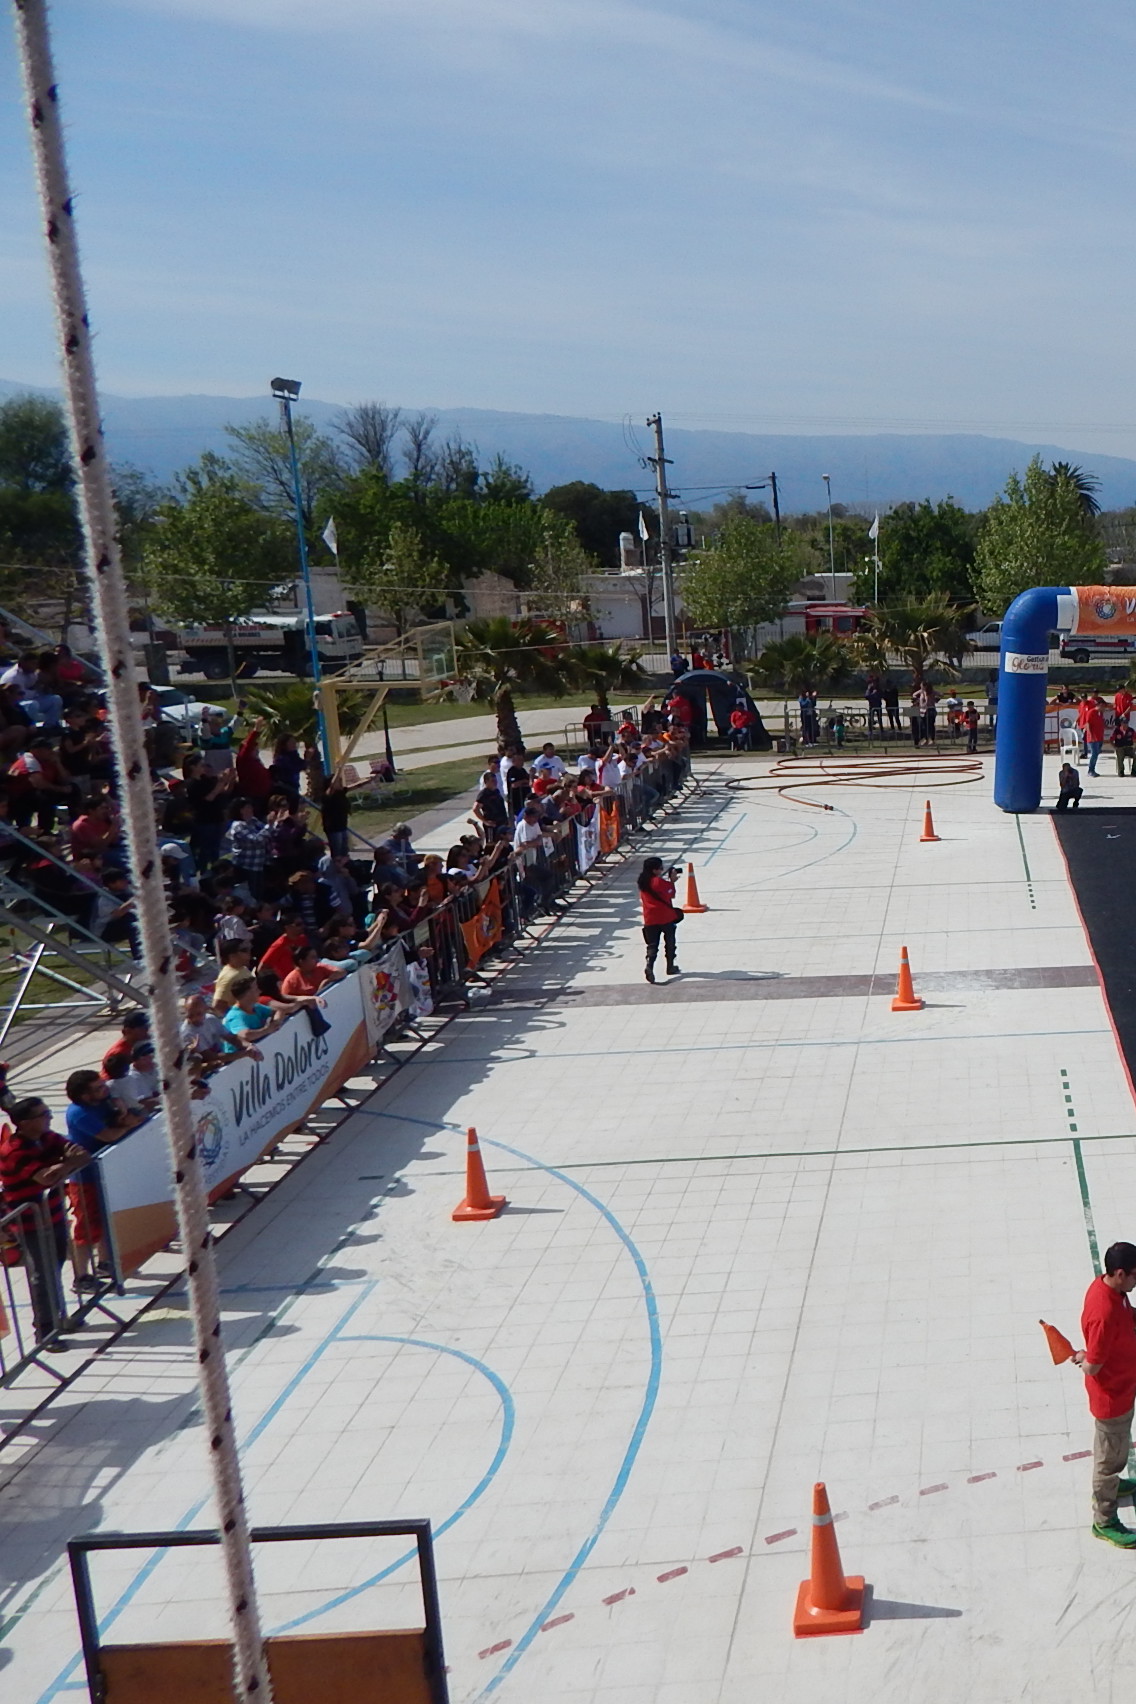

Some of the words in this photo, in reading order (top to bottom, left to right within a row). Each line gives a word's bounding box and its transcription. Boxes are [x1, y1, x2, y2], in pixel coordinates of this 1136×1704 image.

[230, 1061, 272, 1128] Villa
[274, 1031, 329, 1093] Dolores
[250, 1099, 286, 1136] HACEMOS
